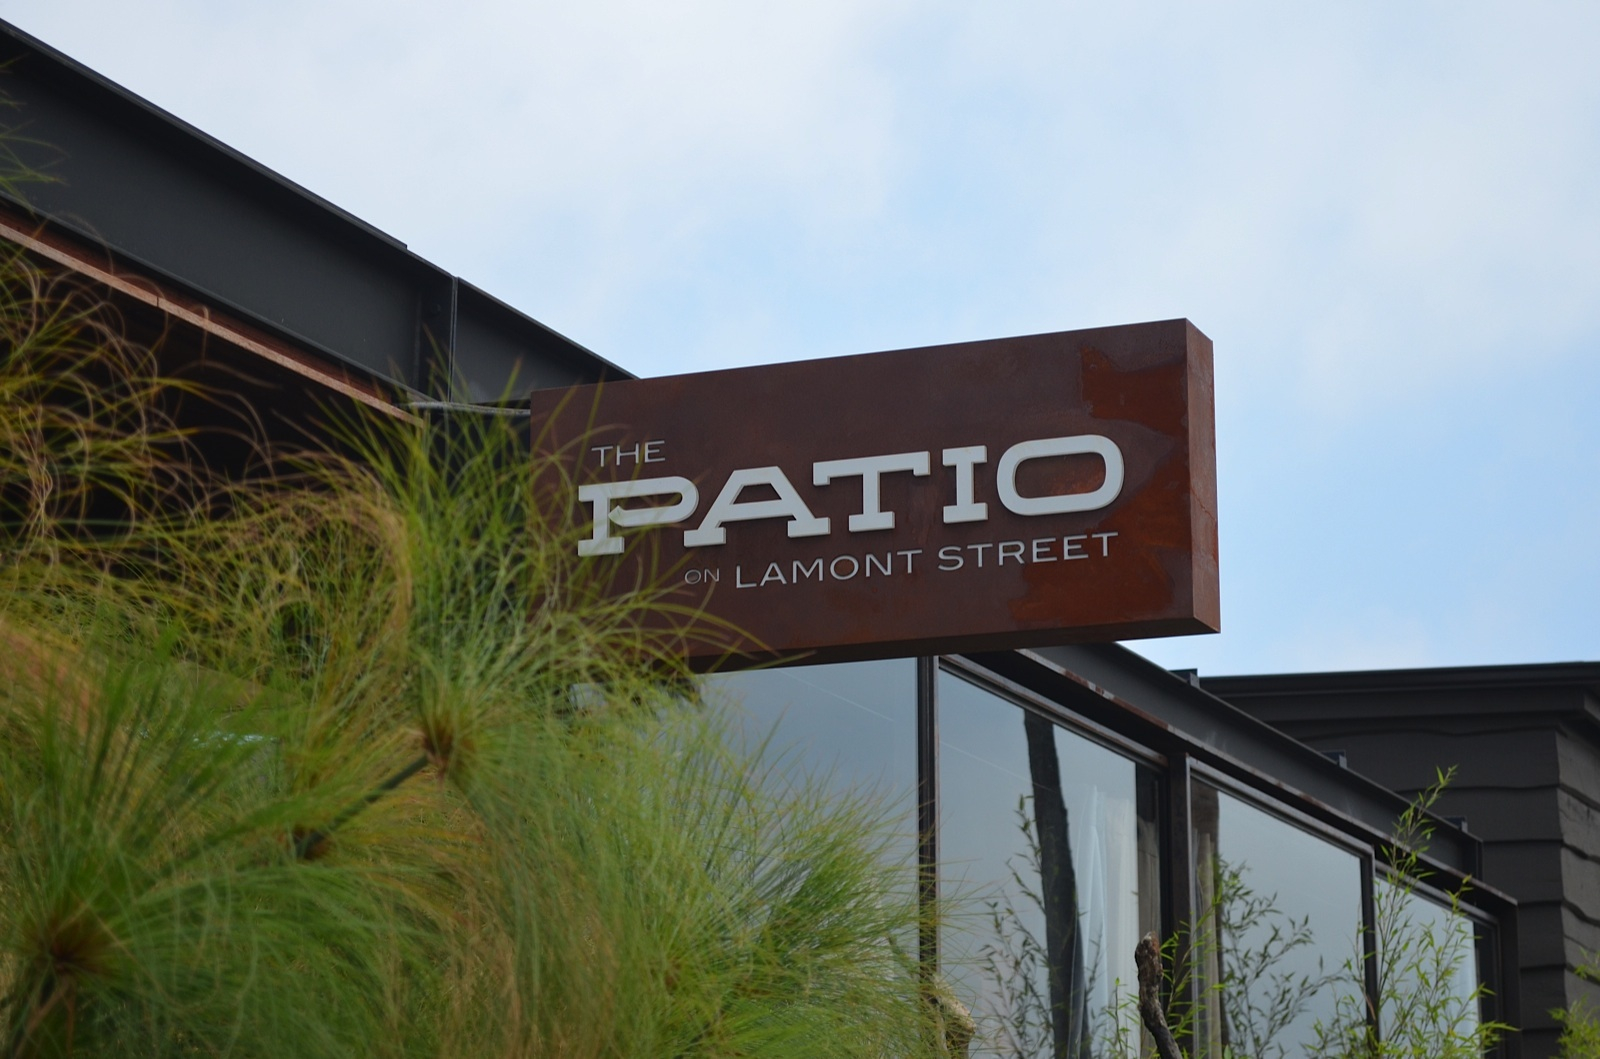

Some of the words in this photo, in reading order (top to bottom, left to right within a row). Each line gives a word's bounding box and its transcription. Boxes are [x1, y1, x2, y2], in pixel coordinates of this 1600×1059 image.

[591, 440, 666, 467] THE
[577, 434, 1125, 557] PATIO
[684, 567, 720, 584] ON
[735, 549, 923, 589] LAMONT
[937, 531, 1119, 571] STREET
